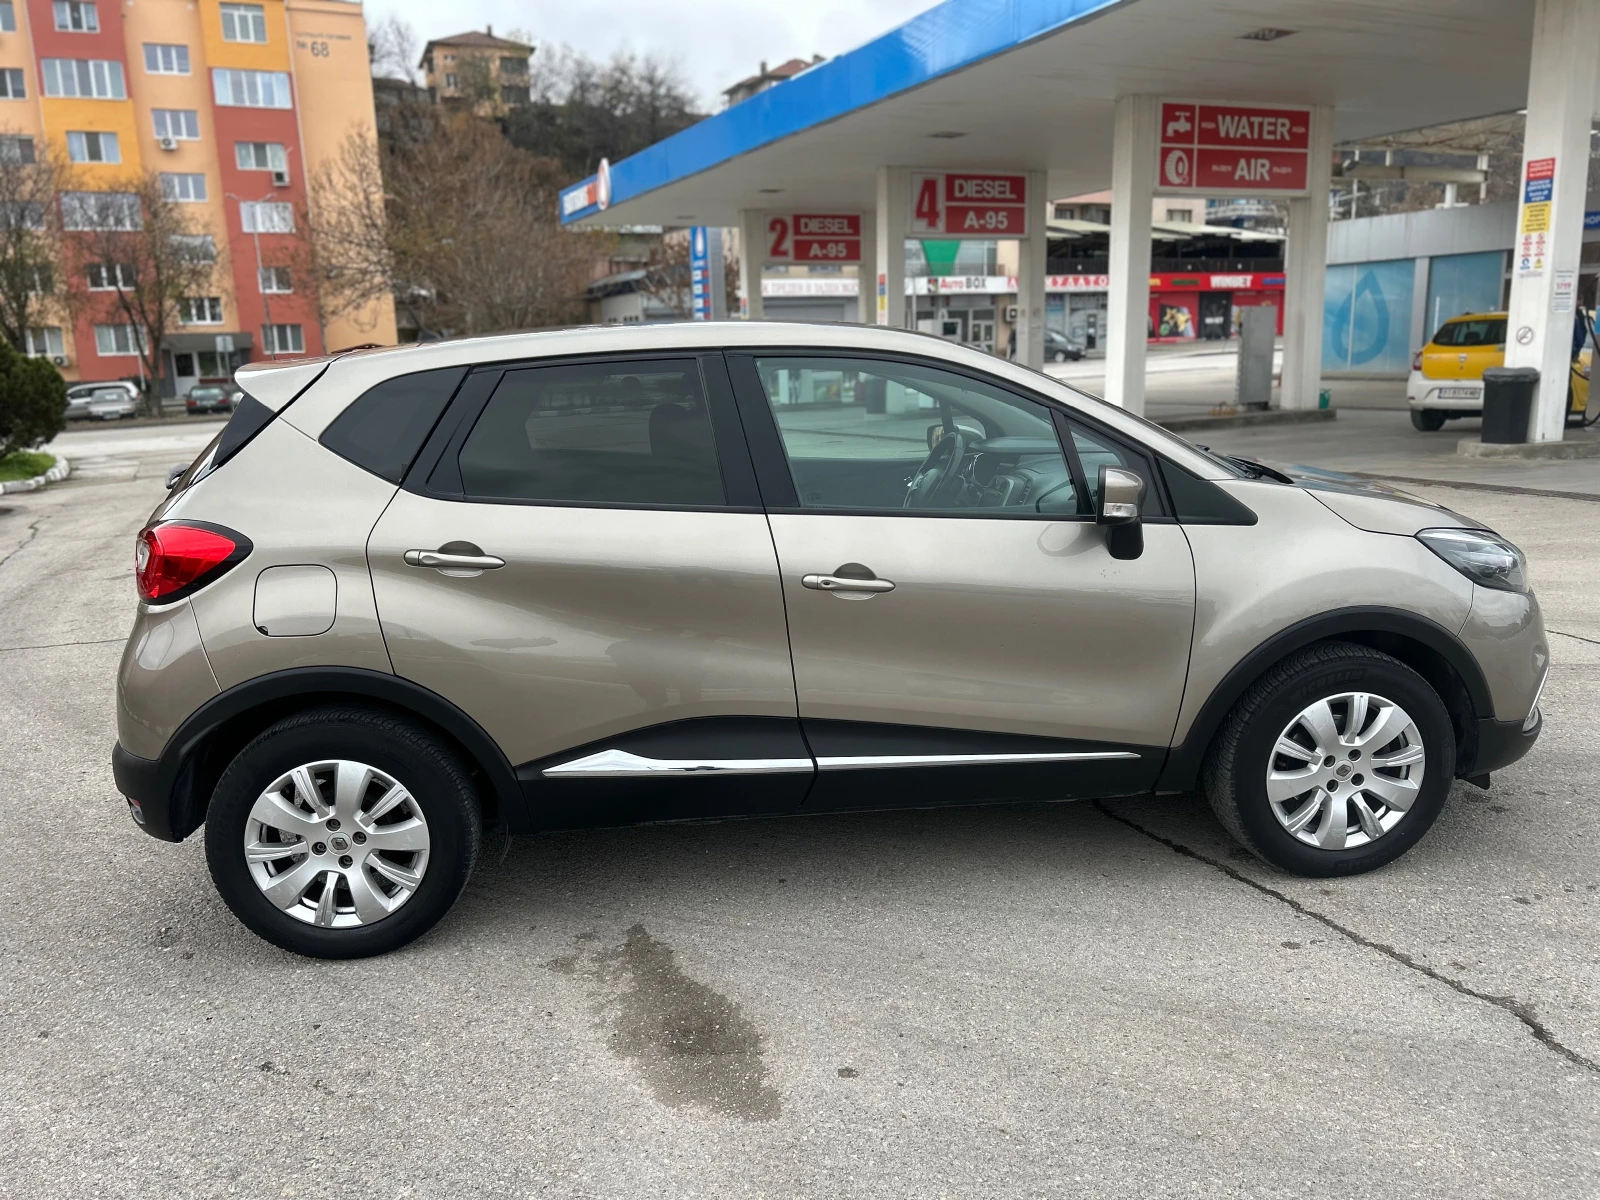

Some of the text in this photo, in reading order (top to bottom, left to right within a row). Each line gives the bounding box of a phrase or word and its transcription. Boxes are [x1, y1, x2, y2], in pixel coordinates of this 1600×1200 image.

[310, 41, 329, 57] 68
[1217, 114, 1291, 141] WATER
[1233, 157, 1271, 182] AIR
[954, 179, 1017, 199] DIESEL
[915, 178, 939, 229] 4
[800, 217, 854, 234] DIESEL
[963, 210, 1009, 230] A-95
[768, 216, 789, 258] 2
[808, 242, 848, 258] A-95
[965, 277, 987, 289] BOX
